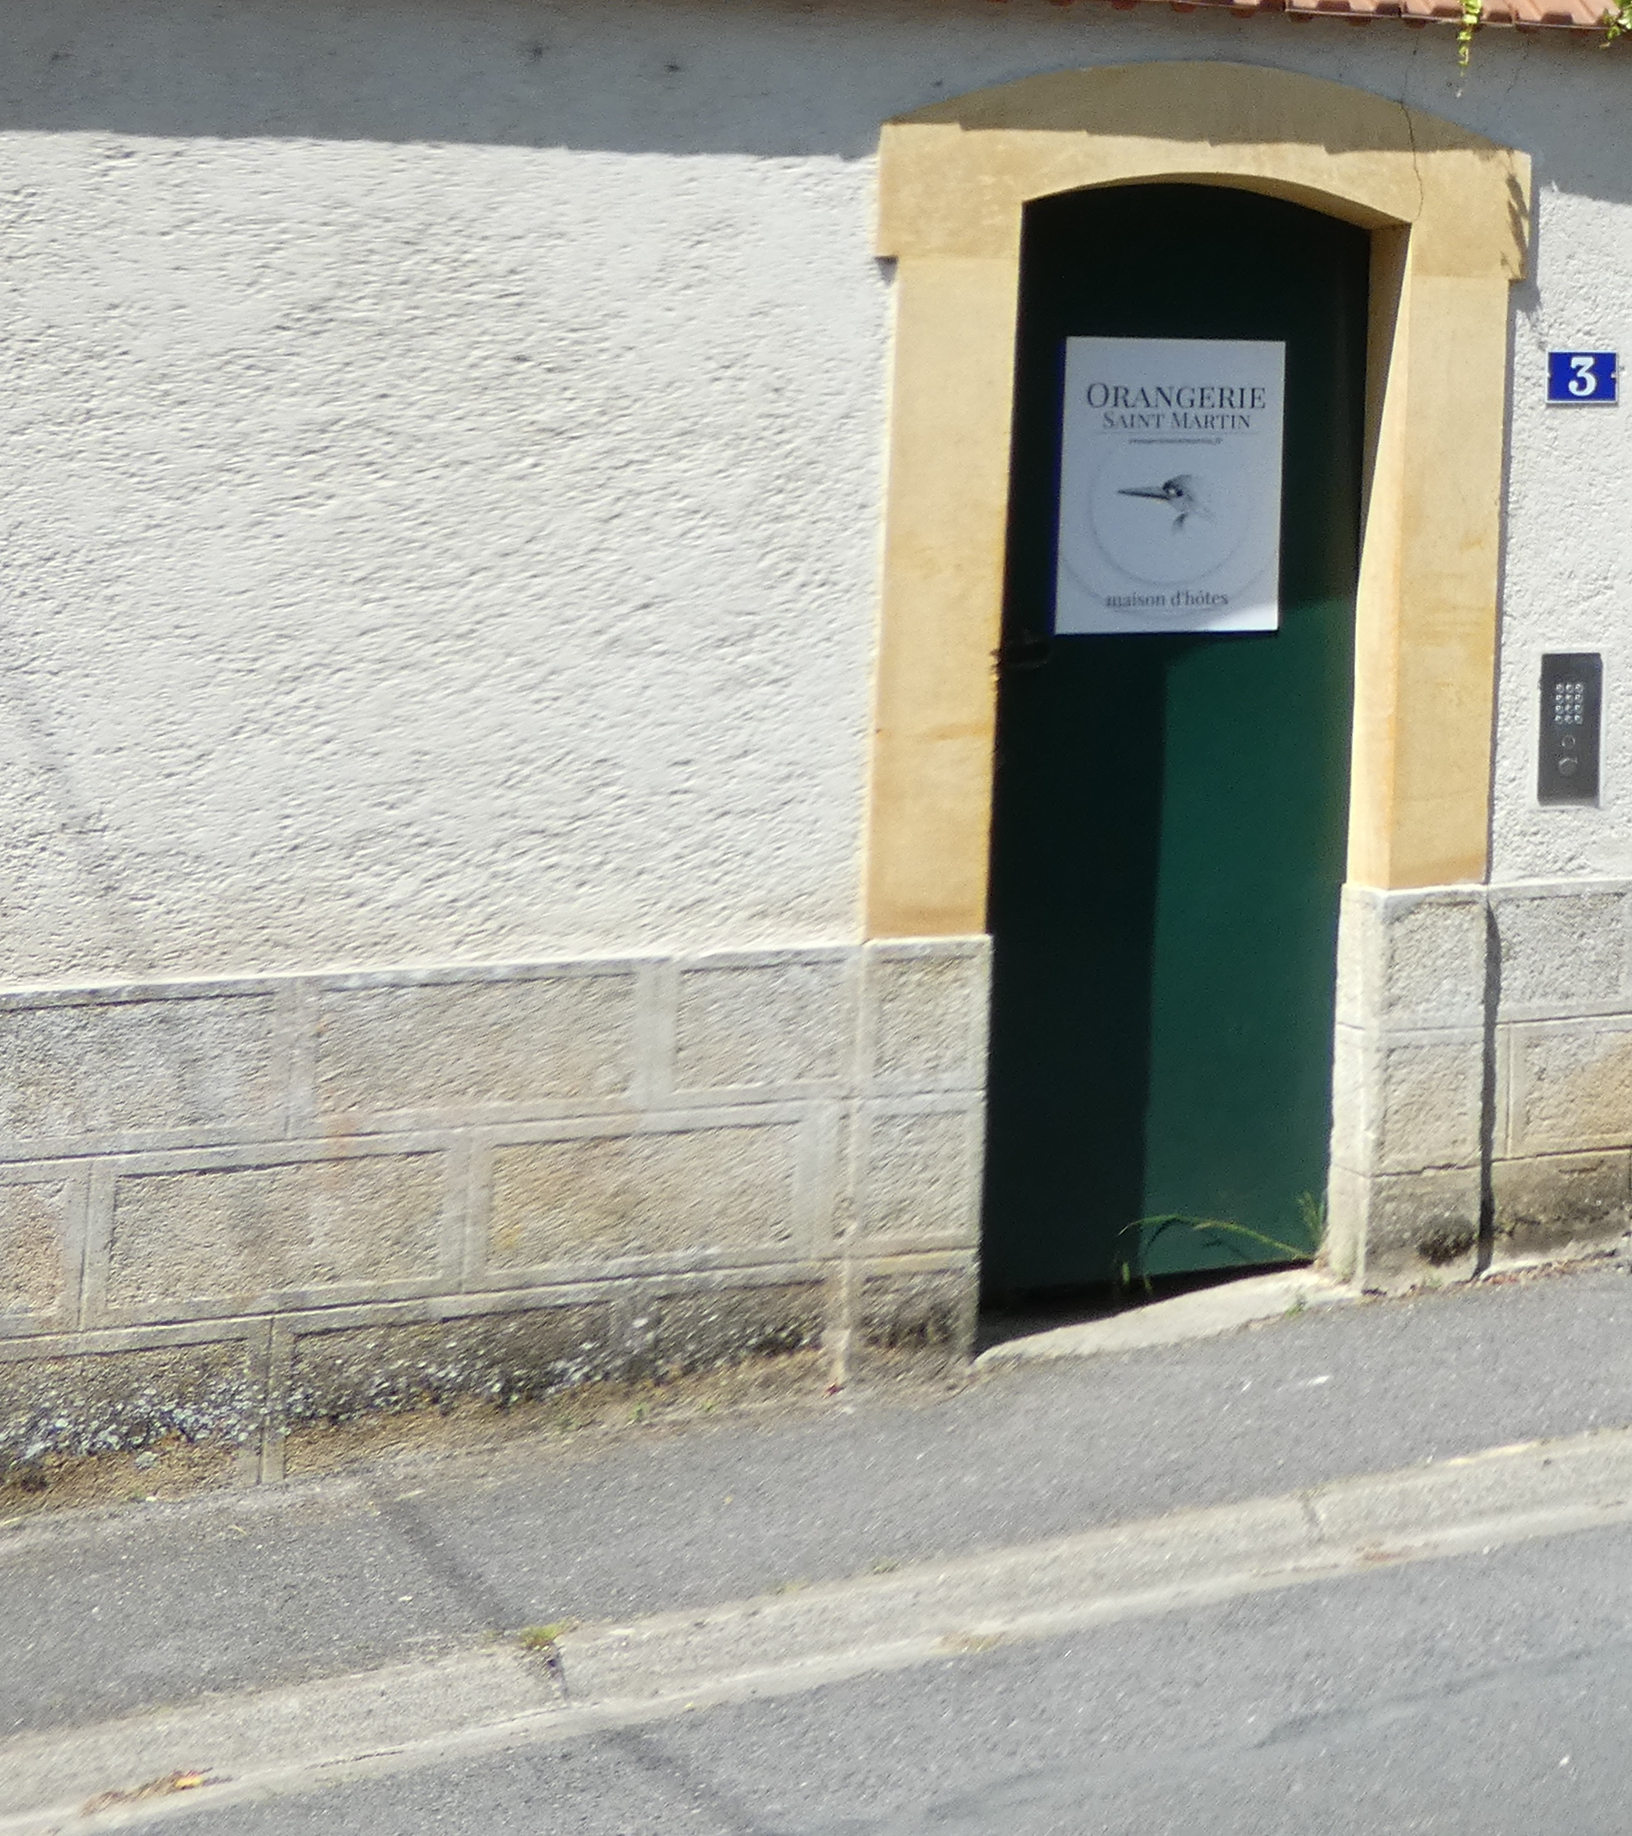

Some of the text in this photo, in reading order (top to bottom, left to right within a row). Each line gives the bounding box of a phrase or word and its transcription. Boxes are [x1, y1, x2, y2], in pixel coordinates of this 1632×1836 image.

[1568, 356, 1596, 397] 3
[1086, 382, 1267, 409] ORANGERIE
[1103, 411, 1251, 430] SAINT MARTIN
[1106, 592, 1165, 606] maison
